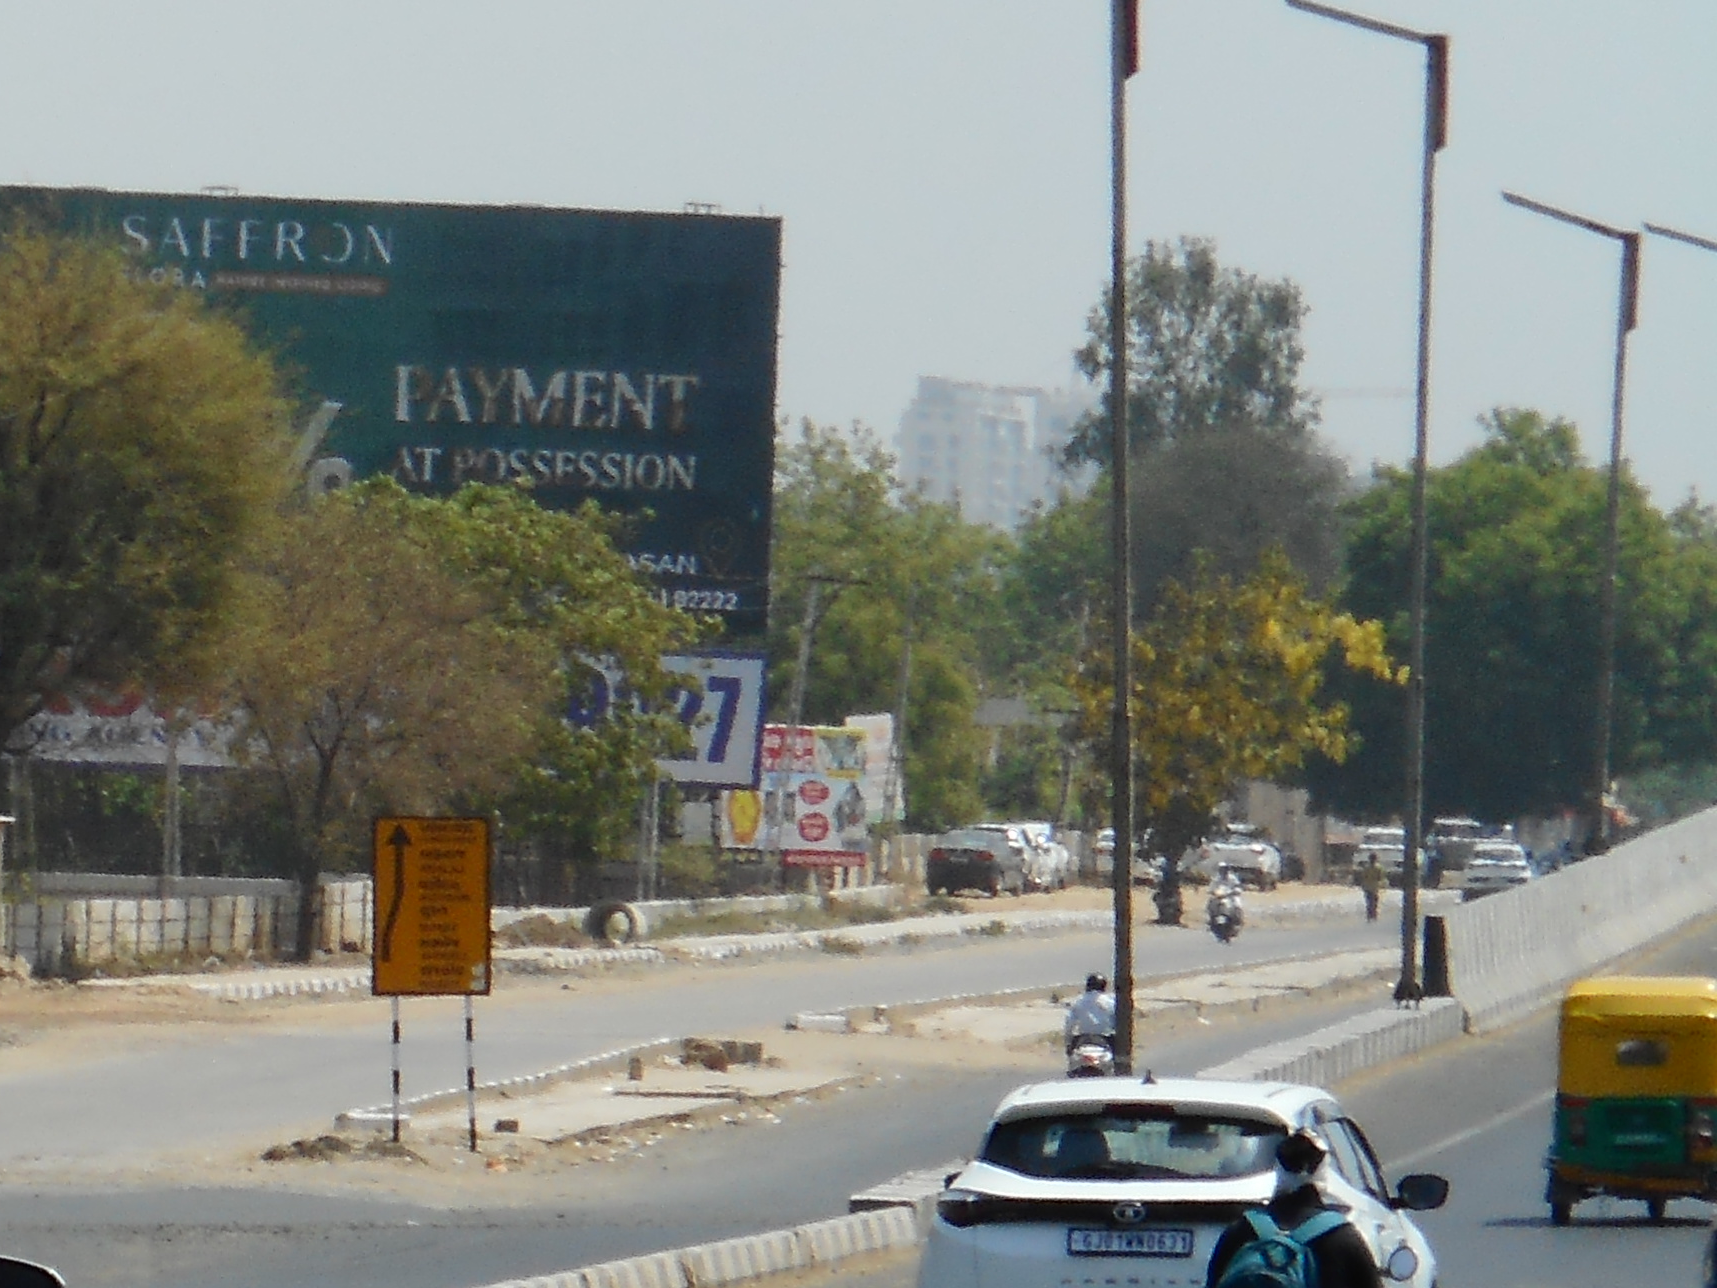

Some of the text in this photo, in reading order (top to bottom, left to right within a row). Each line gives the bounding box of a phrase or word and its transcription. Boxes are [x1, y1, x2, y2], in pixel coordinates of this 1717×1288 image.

[120, 215, 393, 264] SAFFRON
[396, 365, 699, 431] PAYMENT
[394, 446, 697, 492] AT POSSESSION
